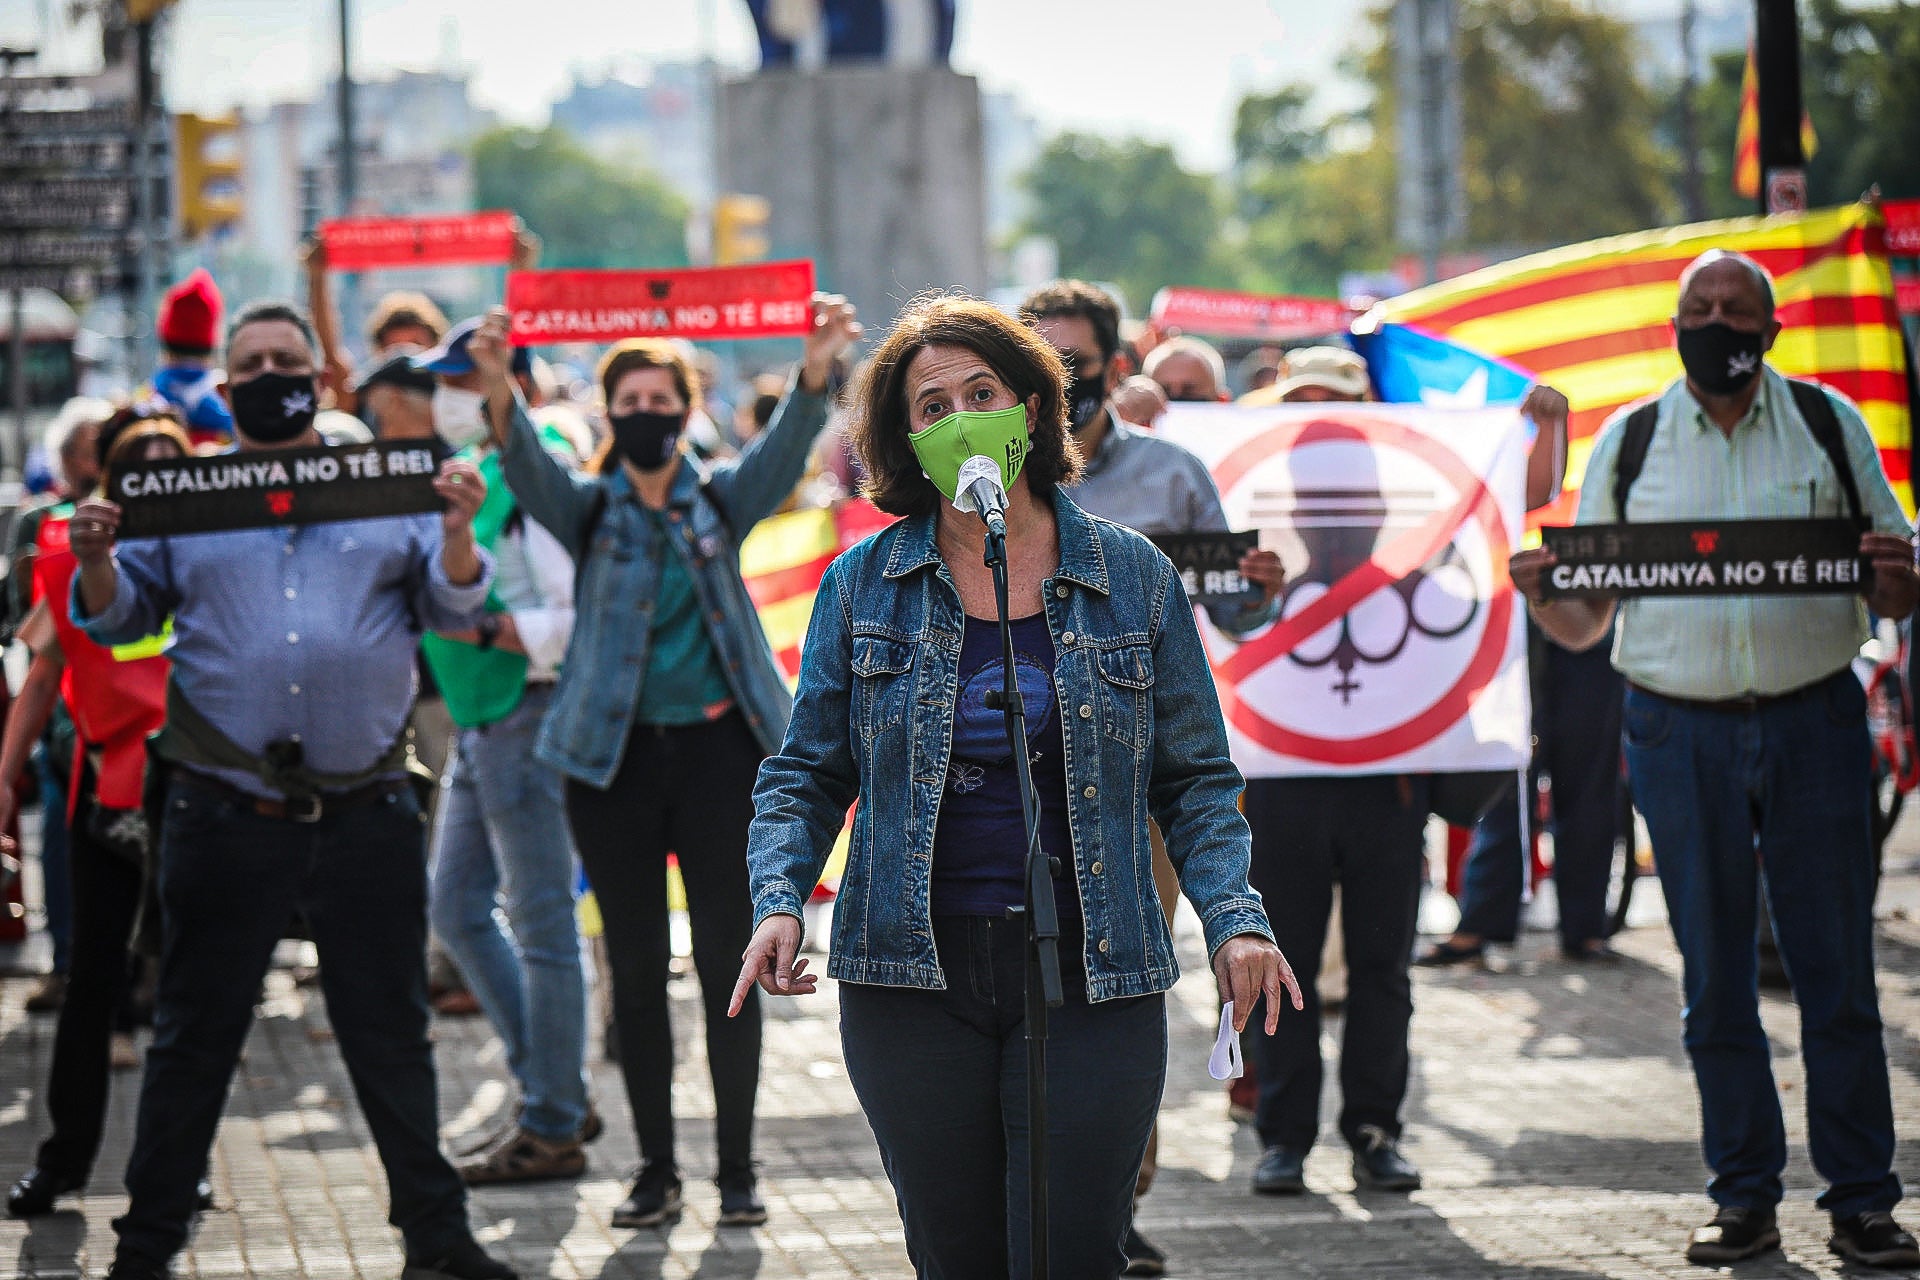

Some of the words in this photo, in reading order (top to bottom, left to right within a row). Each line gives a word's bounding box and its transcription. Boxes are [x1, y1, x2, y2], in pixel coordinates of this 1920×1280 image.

[512, 308, 670, 334] CATALUNYA
[675, 304, 718, 330] NO
[723, 298, 756, 327] TÉ
[761, 302, 806, 326] REI
[121, 460, 290, 496] CATALUNYA
[294, 456, 341, 482] NO
[344, 448, 382, 478] TÉ
[387, 450, 435, 475] REI
[1180, 566, 1199, 595] É
[1552, 561, 1716, 589] CATALUNYA
[1722, 560, 1766, 585] NO
[1772, 555, 1808, 584] TÉ
[1816, 559, 1860, 583] REI
